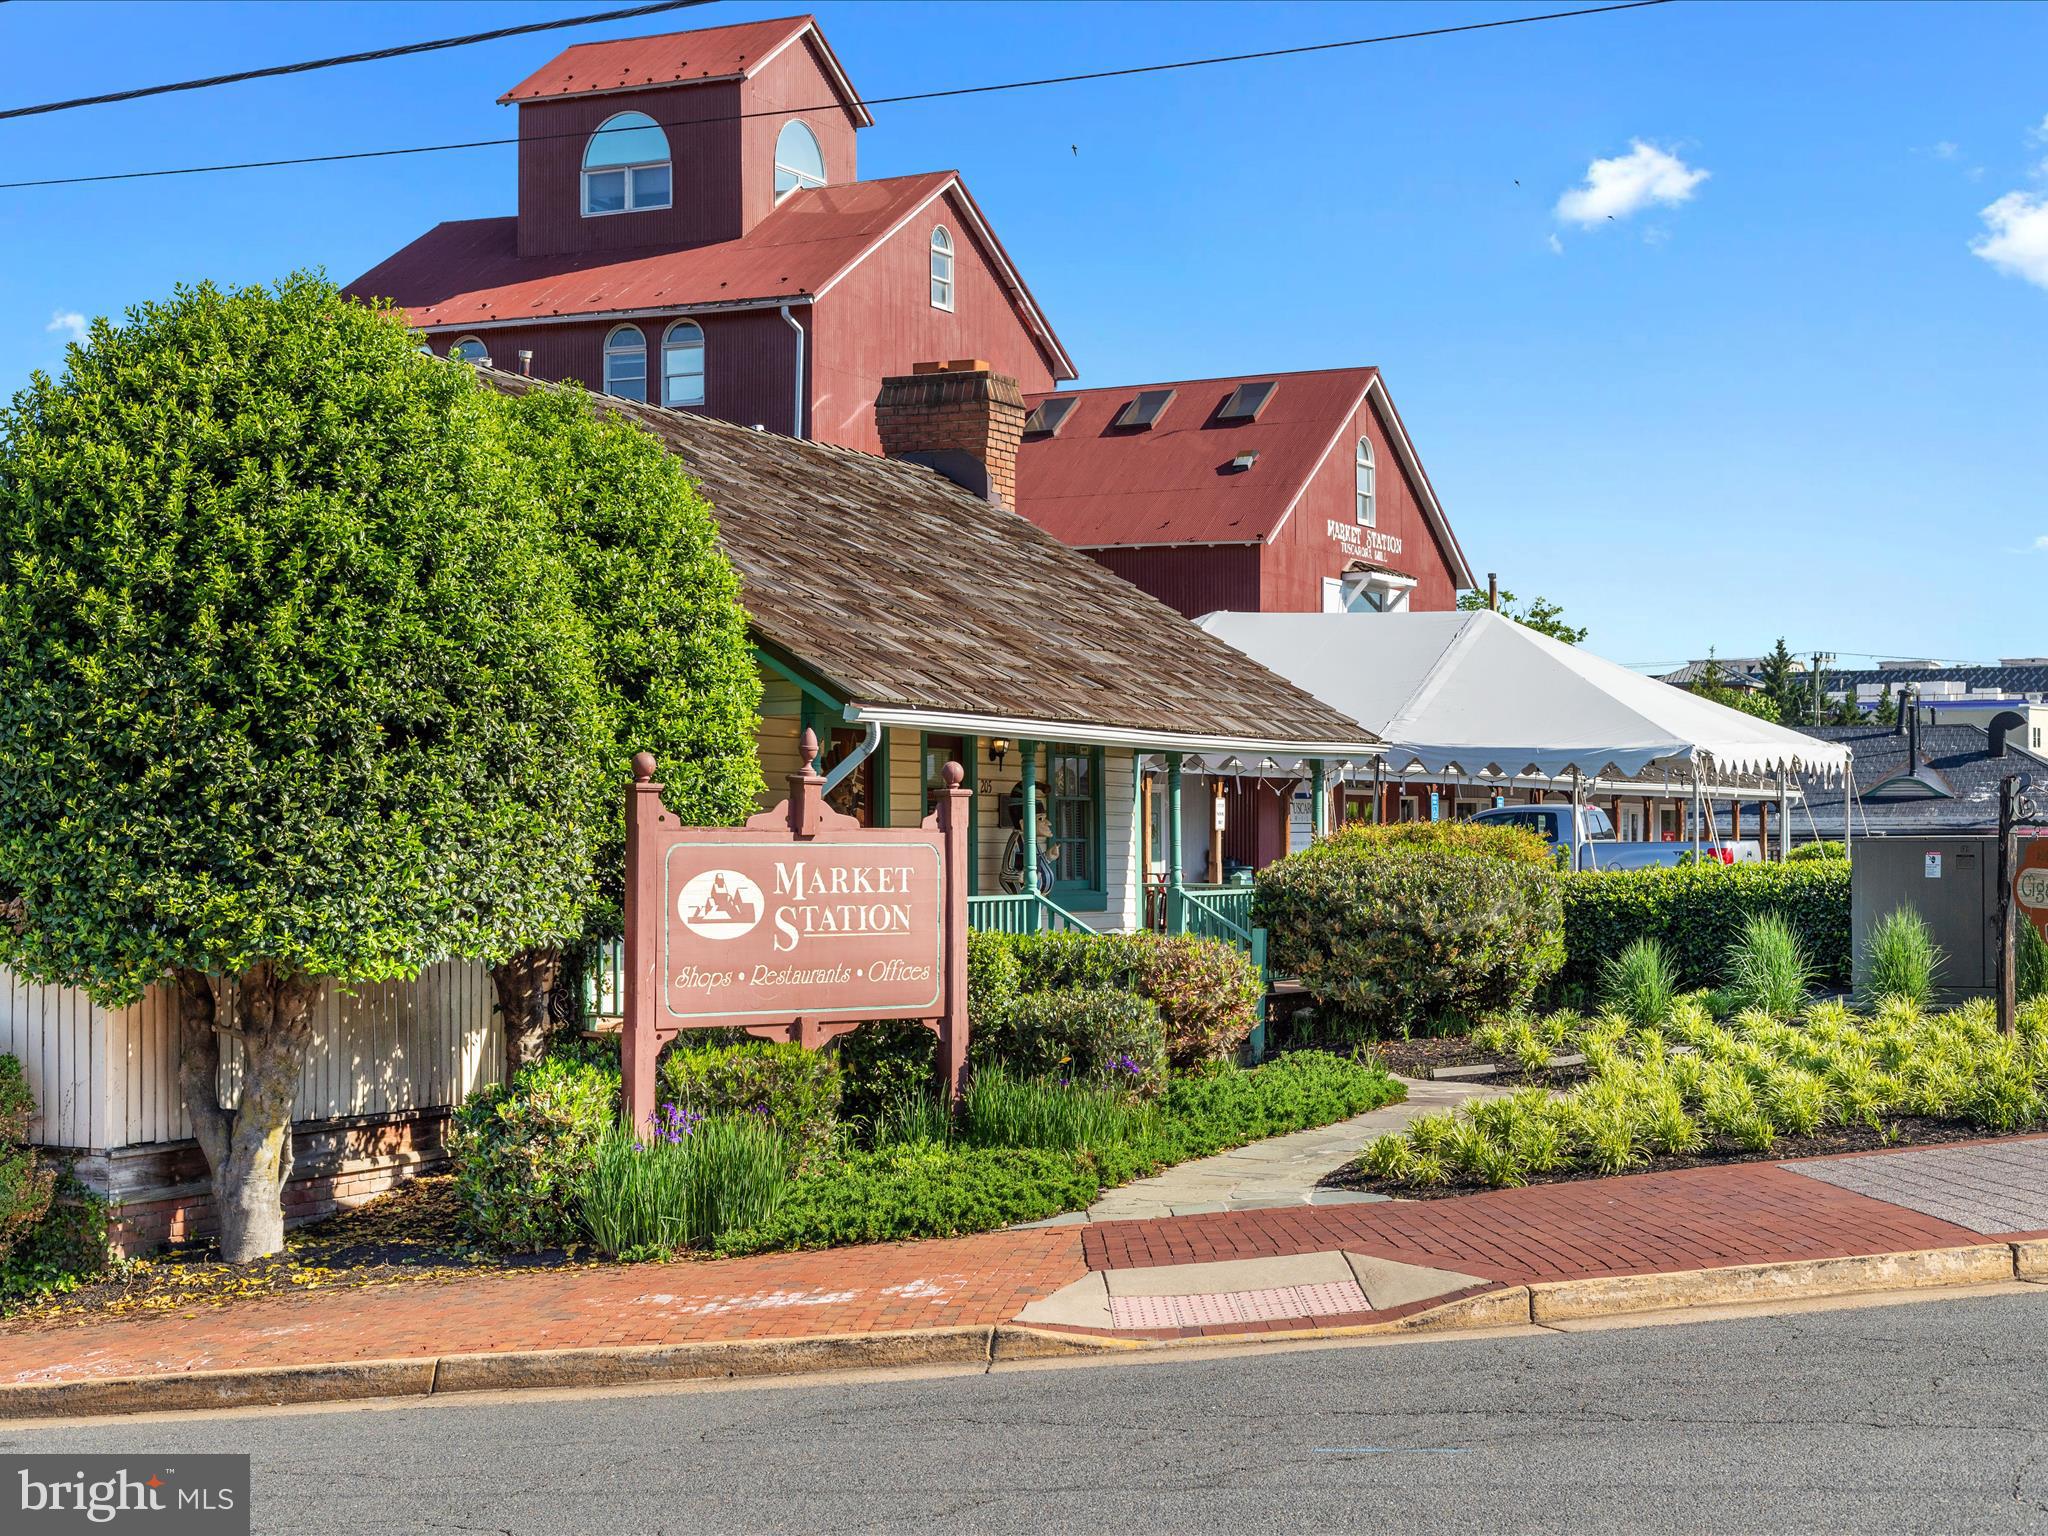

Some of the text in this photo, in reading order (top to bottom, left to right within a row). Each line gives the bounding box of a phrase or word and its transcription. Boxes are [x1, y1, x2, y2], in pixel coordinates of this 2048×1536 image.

[1327, 520, 1402, 555] MARKET STATION
[773, 862, 914, 901] MARKET
[773, 904, 912, 952] STATION
[675, 959, 931, 995] Shops Restaurants Offices
